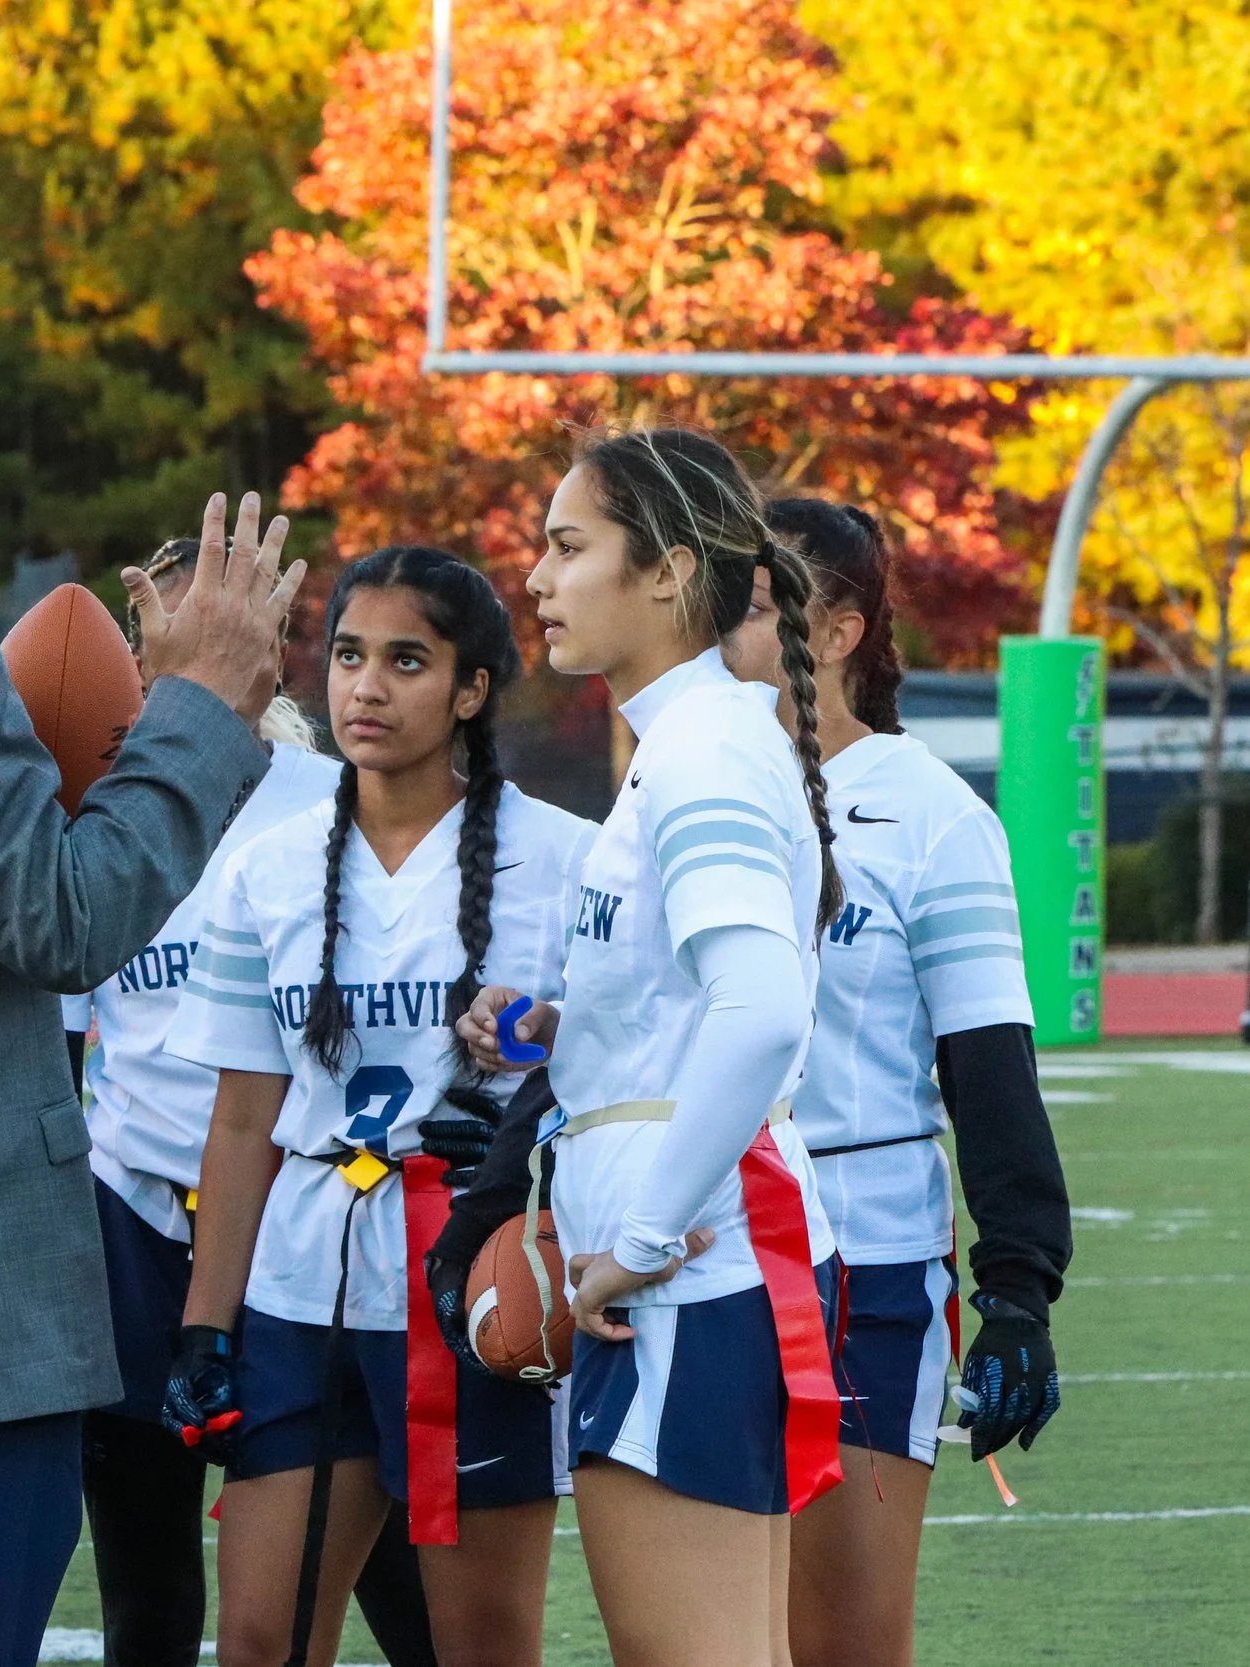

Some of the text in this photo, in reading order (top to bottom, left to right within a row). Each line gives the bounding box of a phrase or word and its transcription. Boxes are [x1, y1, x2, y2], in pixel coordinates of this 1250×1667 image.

[1067, 722, 1101, 1033] TITANS
[576, 885, 623, 943] EW
[117, 941, 199, 993] NOR
[269, 981, 456, 1032] NOTHVI
